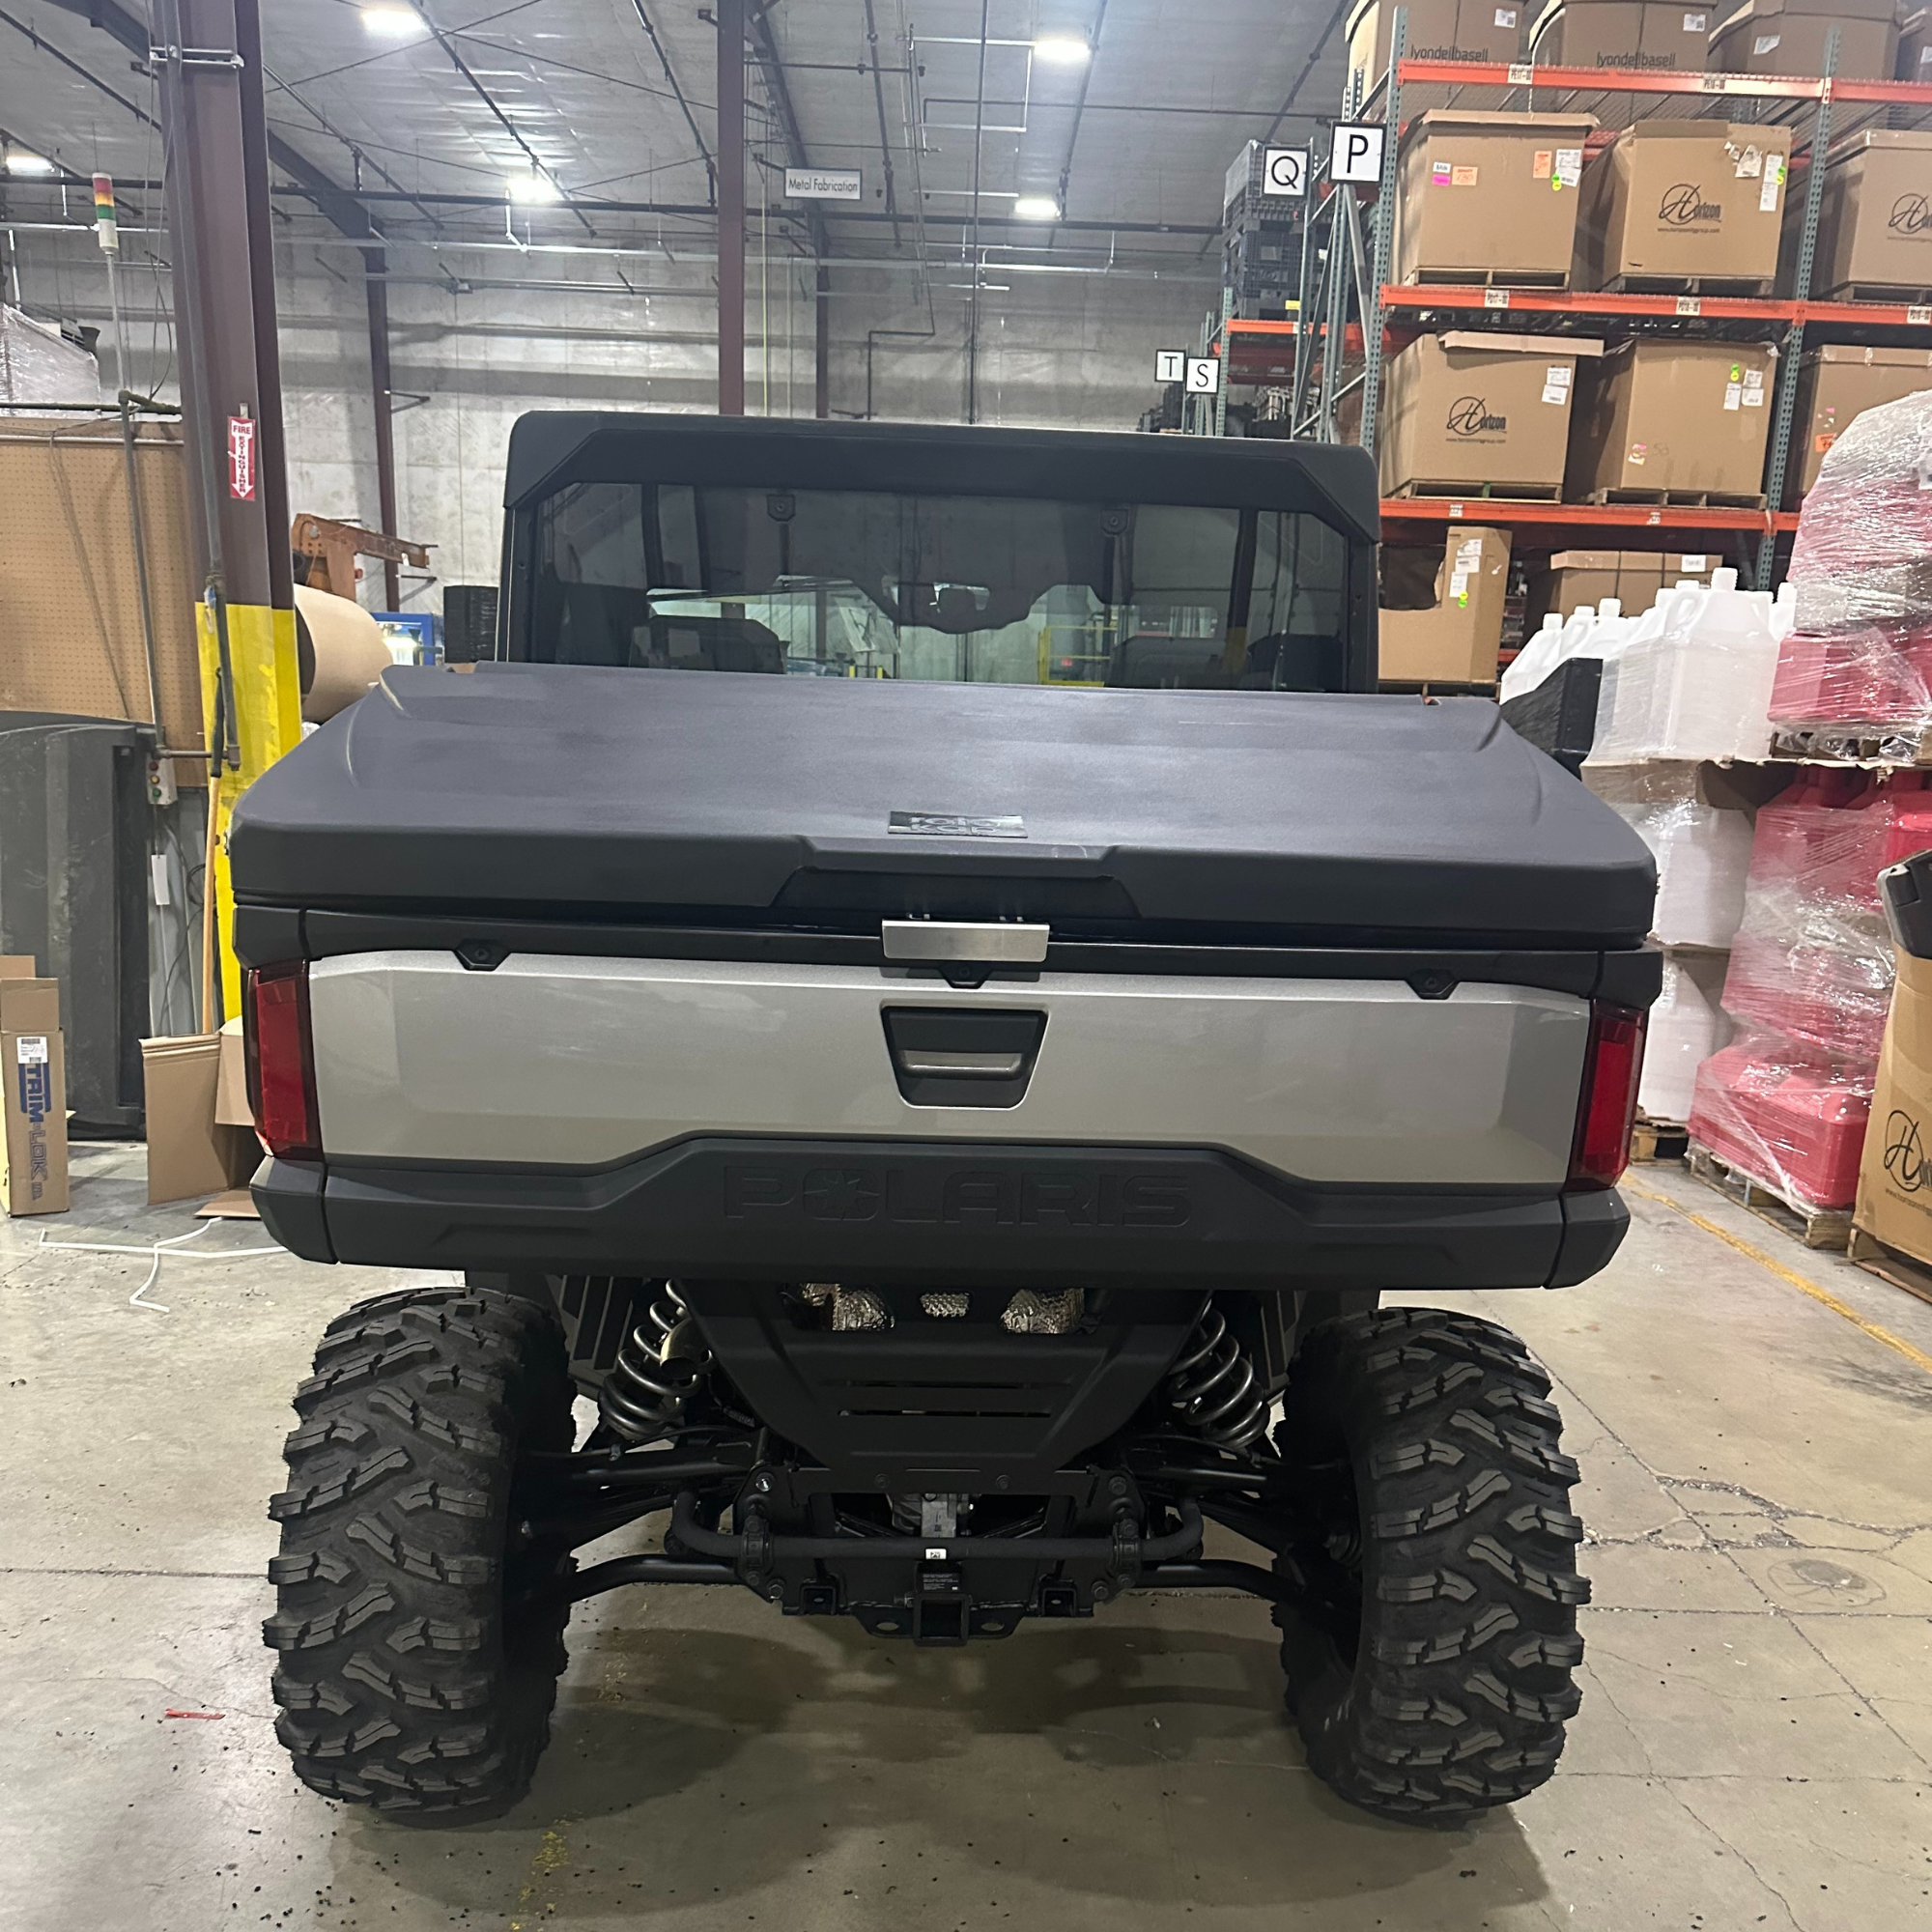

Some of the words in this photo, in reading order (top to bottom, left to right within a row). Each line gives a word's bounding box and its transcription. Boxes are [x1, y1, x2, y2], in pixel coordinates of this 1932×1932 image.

[1410, 43, 1489, 62] lyondellbasell
[1597, 51, 1676, 68] lyondellbasell
[1347, 134, 1369, 174] P
[788, 177, 811, 190] Metal
[813, 177, 858, 192] Fabrication
[1271, 156, 1297, 189] Q
[1659, 184, 1721, 225] Horizon
[1164, 355, 1178, 378] T
[1196, 363, 1208, 387] S
[233, 425, 251, 435] FIRE
[1446, 396, 1507, 436] Horizon
[27, 1064, 48, 1180] TRIM-LOK
[724, 1165, 1191, 1227] POLARIS
